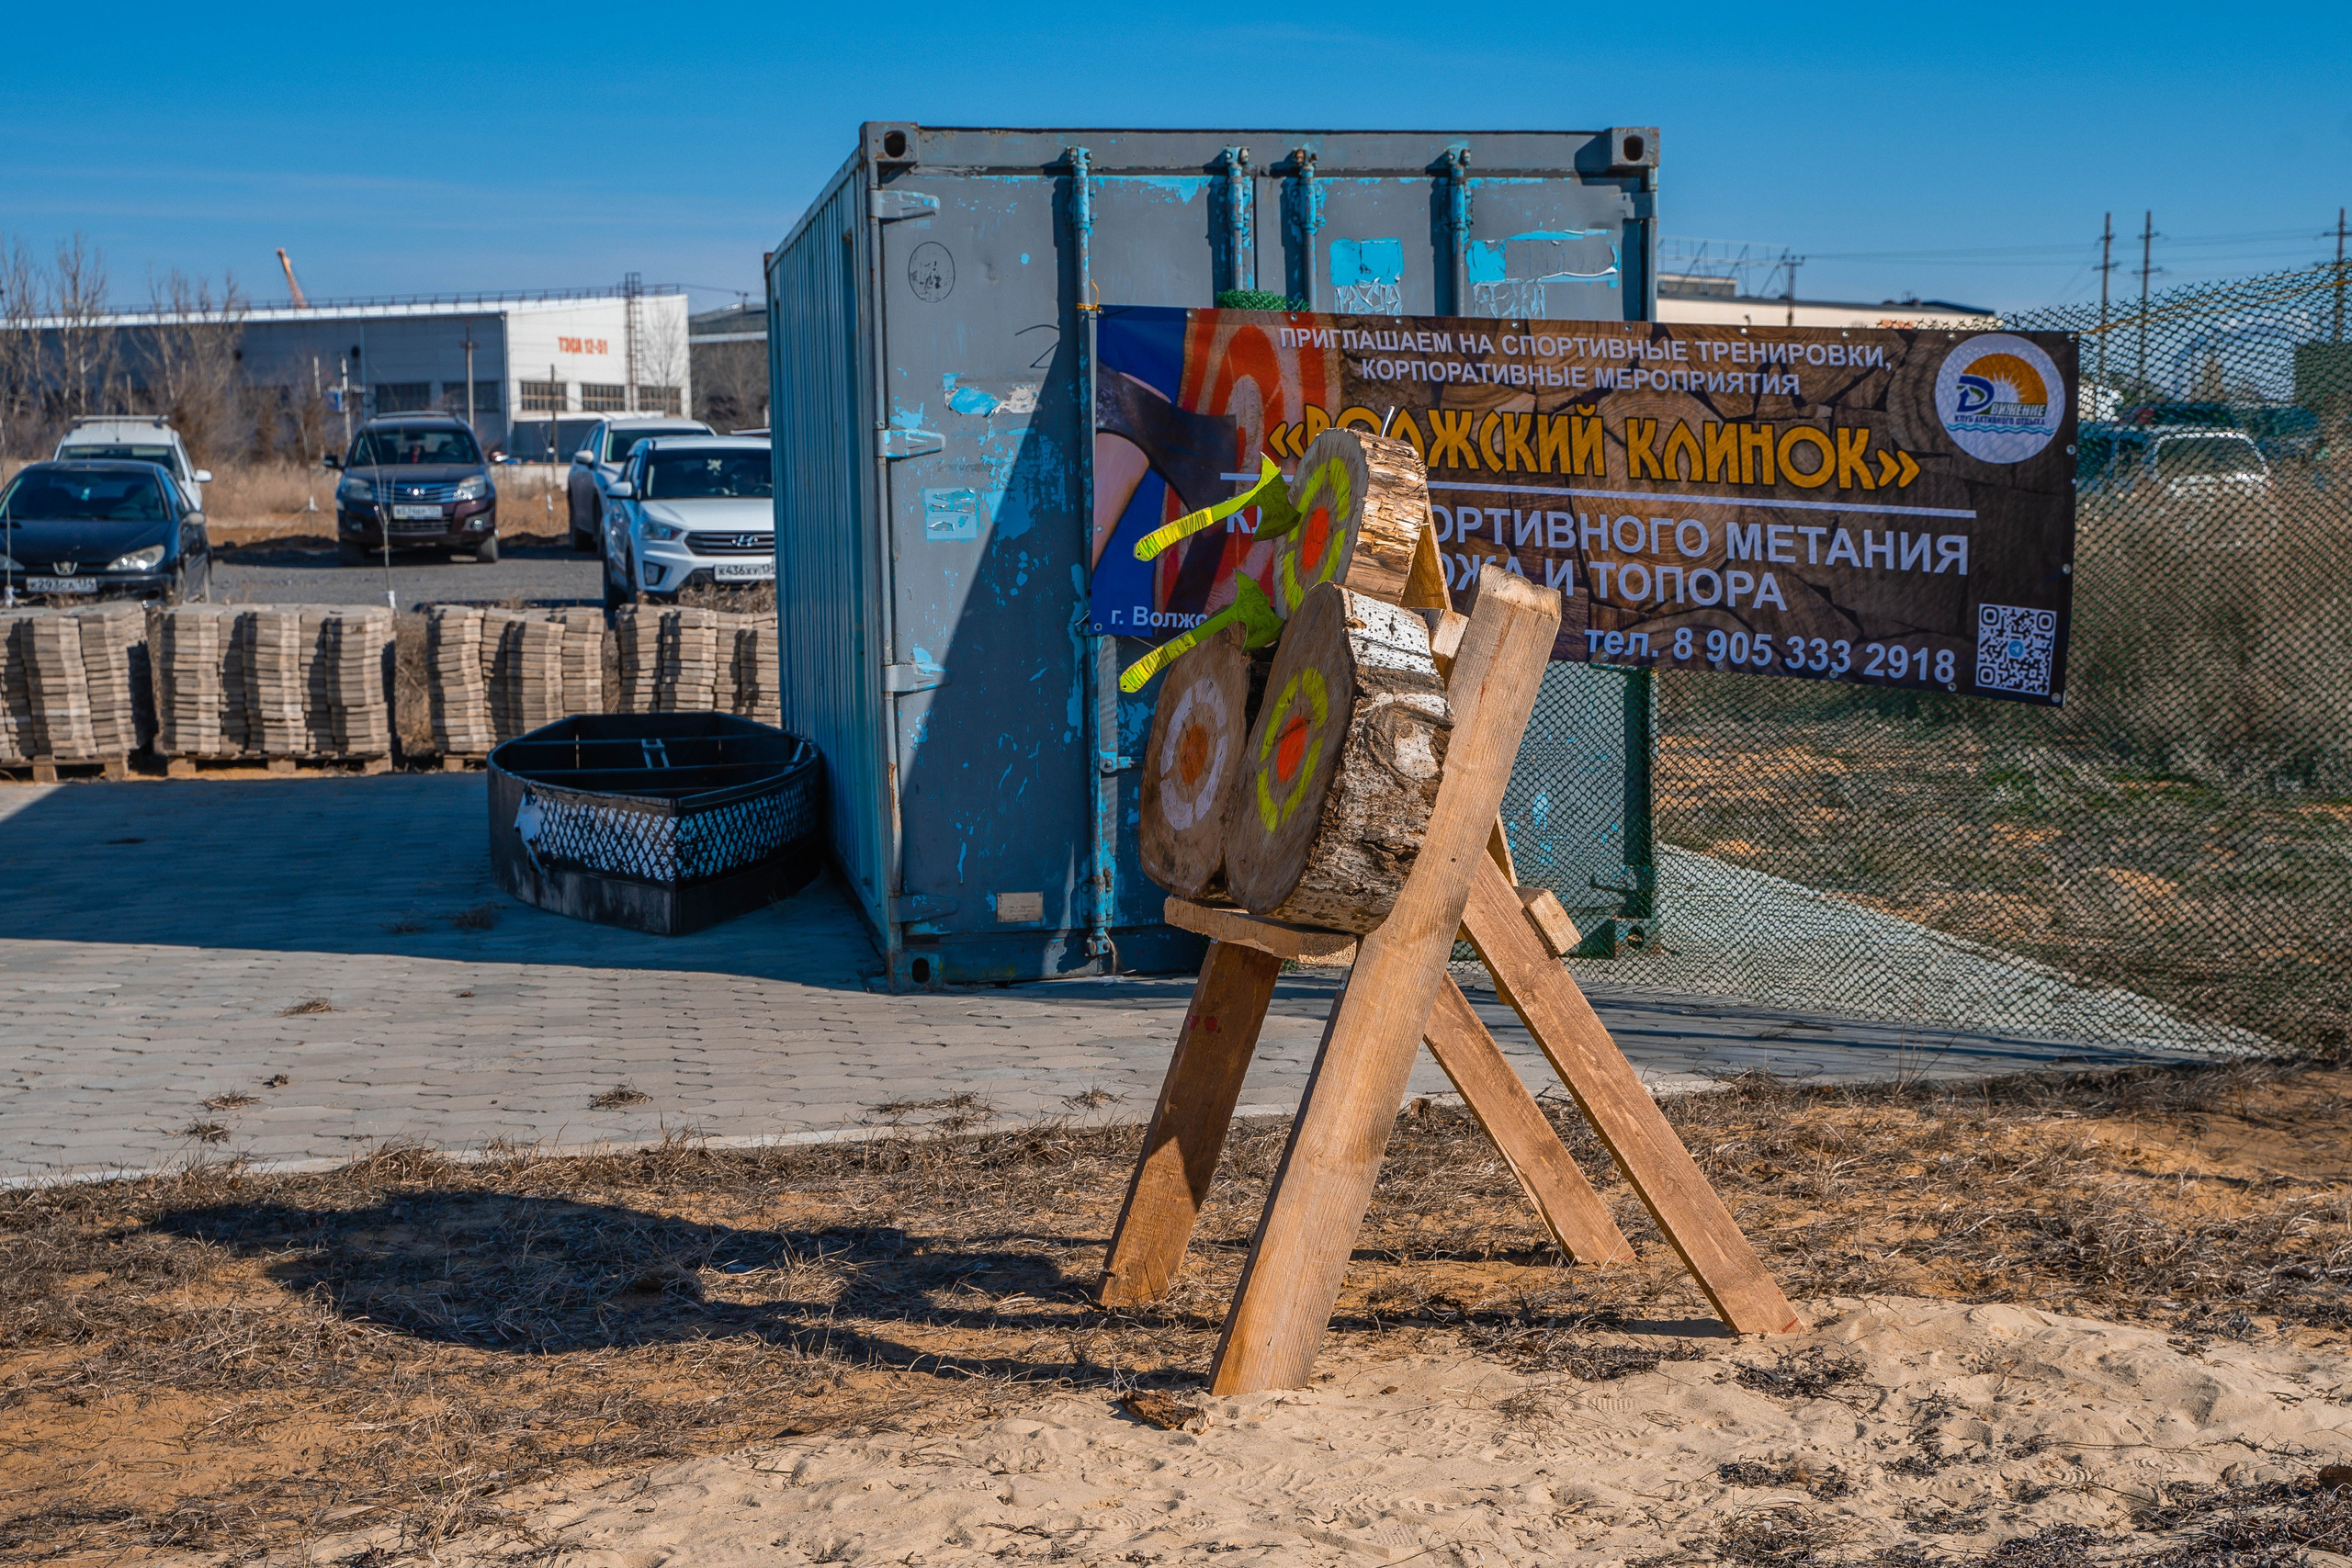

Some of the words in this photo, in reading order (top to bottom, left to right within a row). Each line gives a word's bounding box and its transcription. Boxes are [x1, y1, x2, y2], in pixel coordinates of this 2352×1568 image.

[1280, 328, 1453, 353] ПРИГЛАШАЕМ
[1459, 333, 1496, 355] НА
[1501, 334, 1689, 361] СПОРТИВНЫЕ
[1695, 341, 1893, 371] ТРЕНИРОВКИ,
[1362, 358, 1588, 388] КОРПОРАТИВНЫЕ
[1595, 367, 1800, 396] МЕРОПРИЯТИЯ
[1624, 416, 1921, 491] КЛИНОК»
[1430, 504, 1710, 558] ОРТИВНОГО
[1726, 522, 1969, 576] МЕТАНИЯ
[1589, 560, 1788, 612] ТОПОРА
[1111, 609, 1124, 625] г.
[1132, 605, 1208, 628] Волжс
[1584, 628, 1659, 659] тел.
[1673, 626, 1693, 660] 8
[1706, 629, 1773, 667] 905
[1784, 636, 1852, 673] 333
[1863, 642, 1956, 683] 2918
